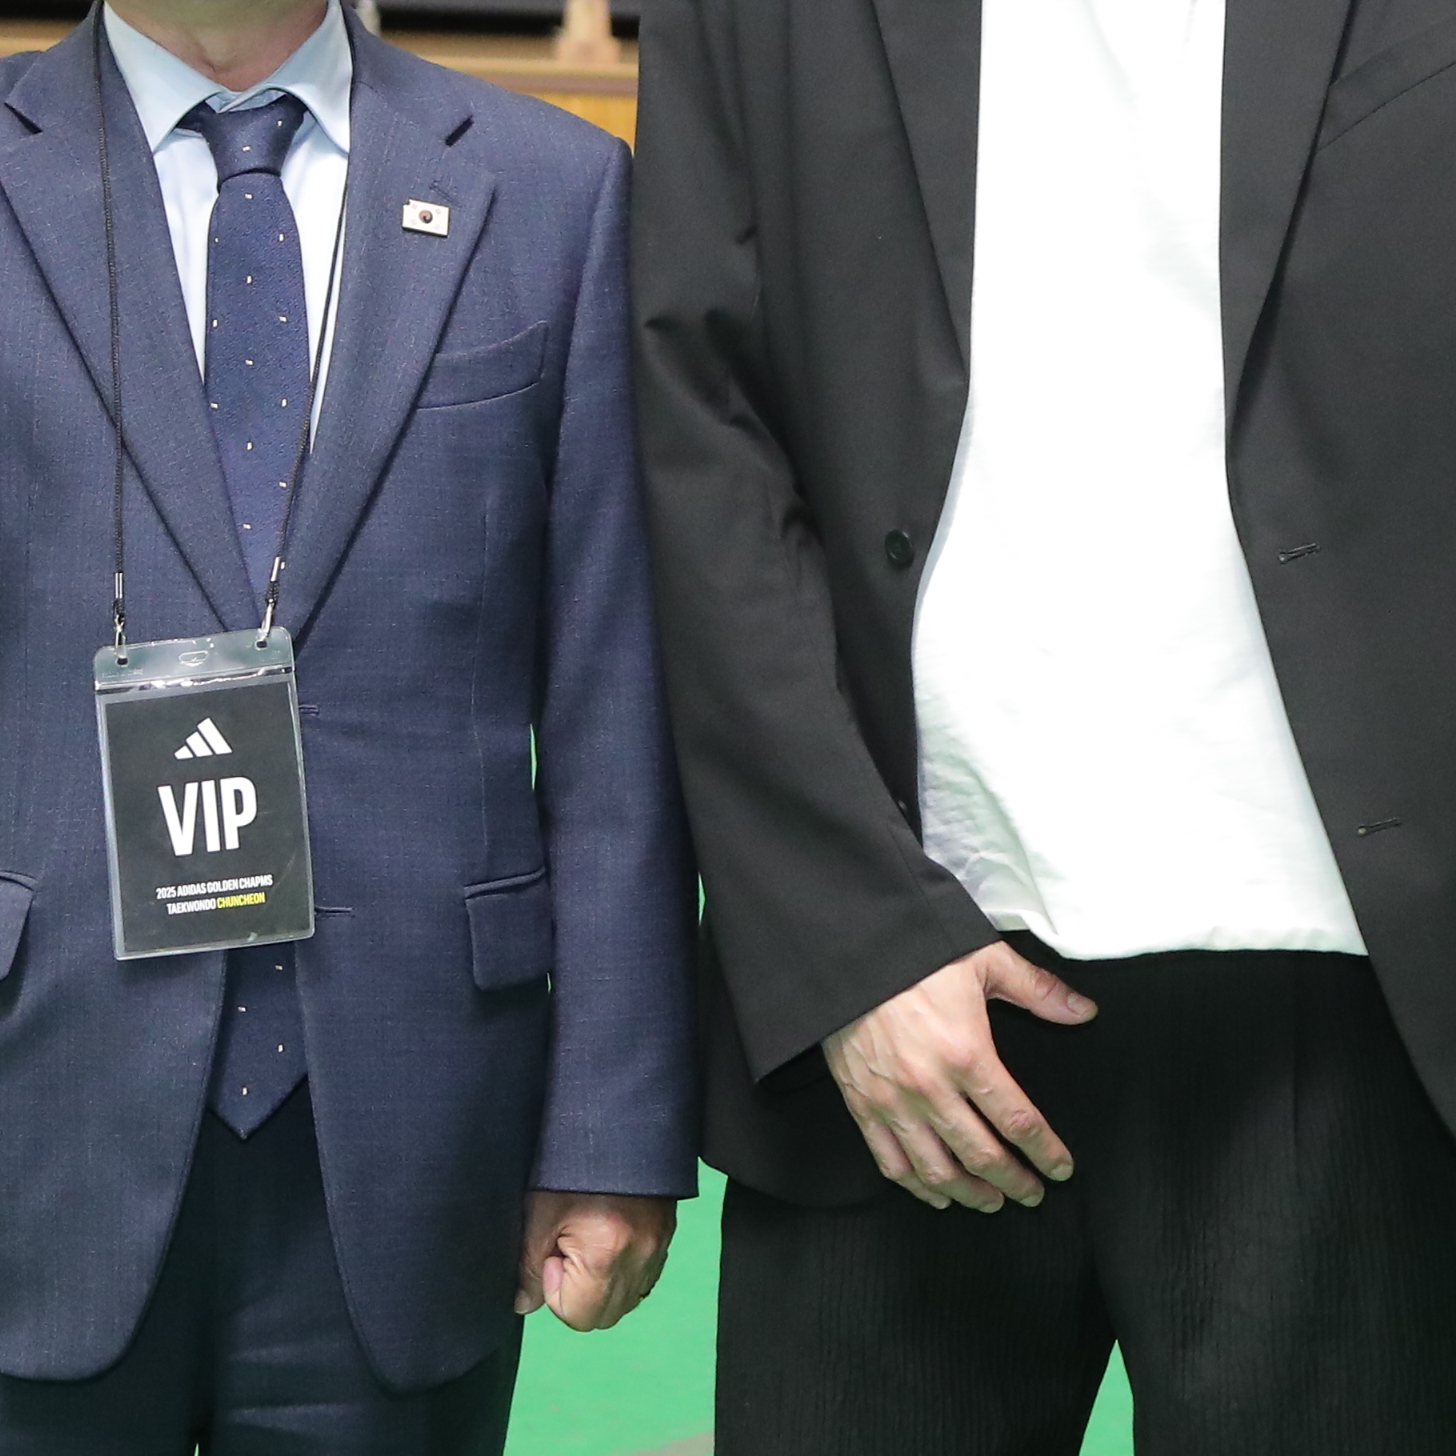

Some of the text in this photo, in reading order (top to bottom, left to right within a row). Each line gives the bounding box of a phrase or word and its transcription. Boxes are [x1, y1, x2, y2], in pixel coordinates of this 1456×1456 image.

[156, 775, 258, 857] VIP
[156, 885, 177, 900] 2025
[177, 883, 207, 897] ADIDAS
[206, 878, 238, 893] GOLDEN
[166, 892, 266, 915] TAEKWONDO CHUNCHEON
